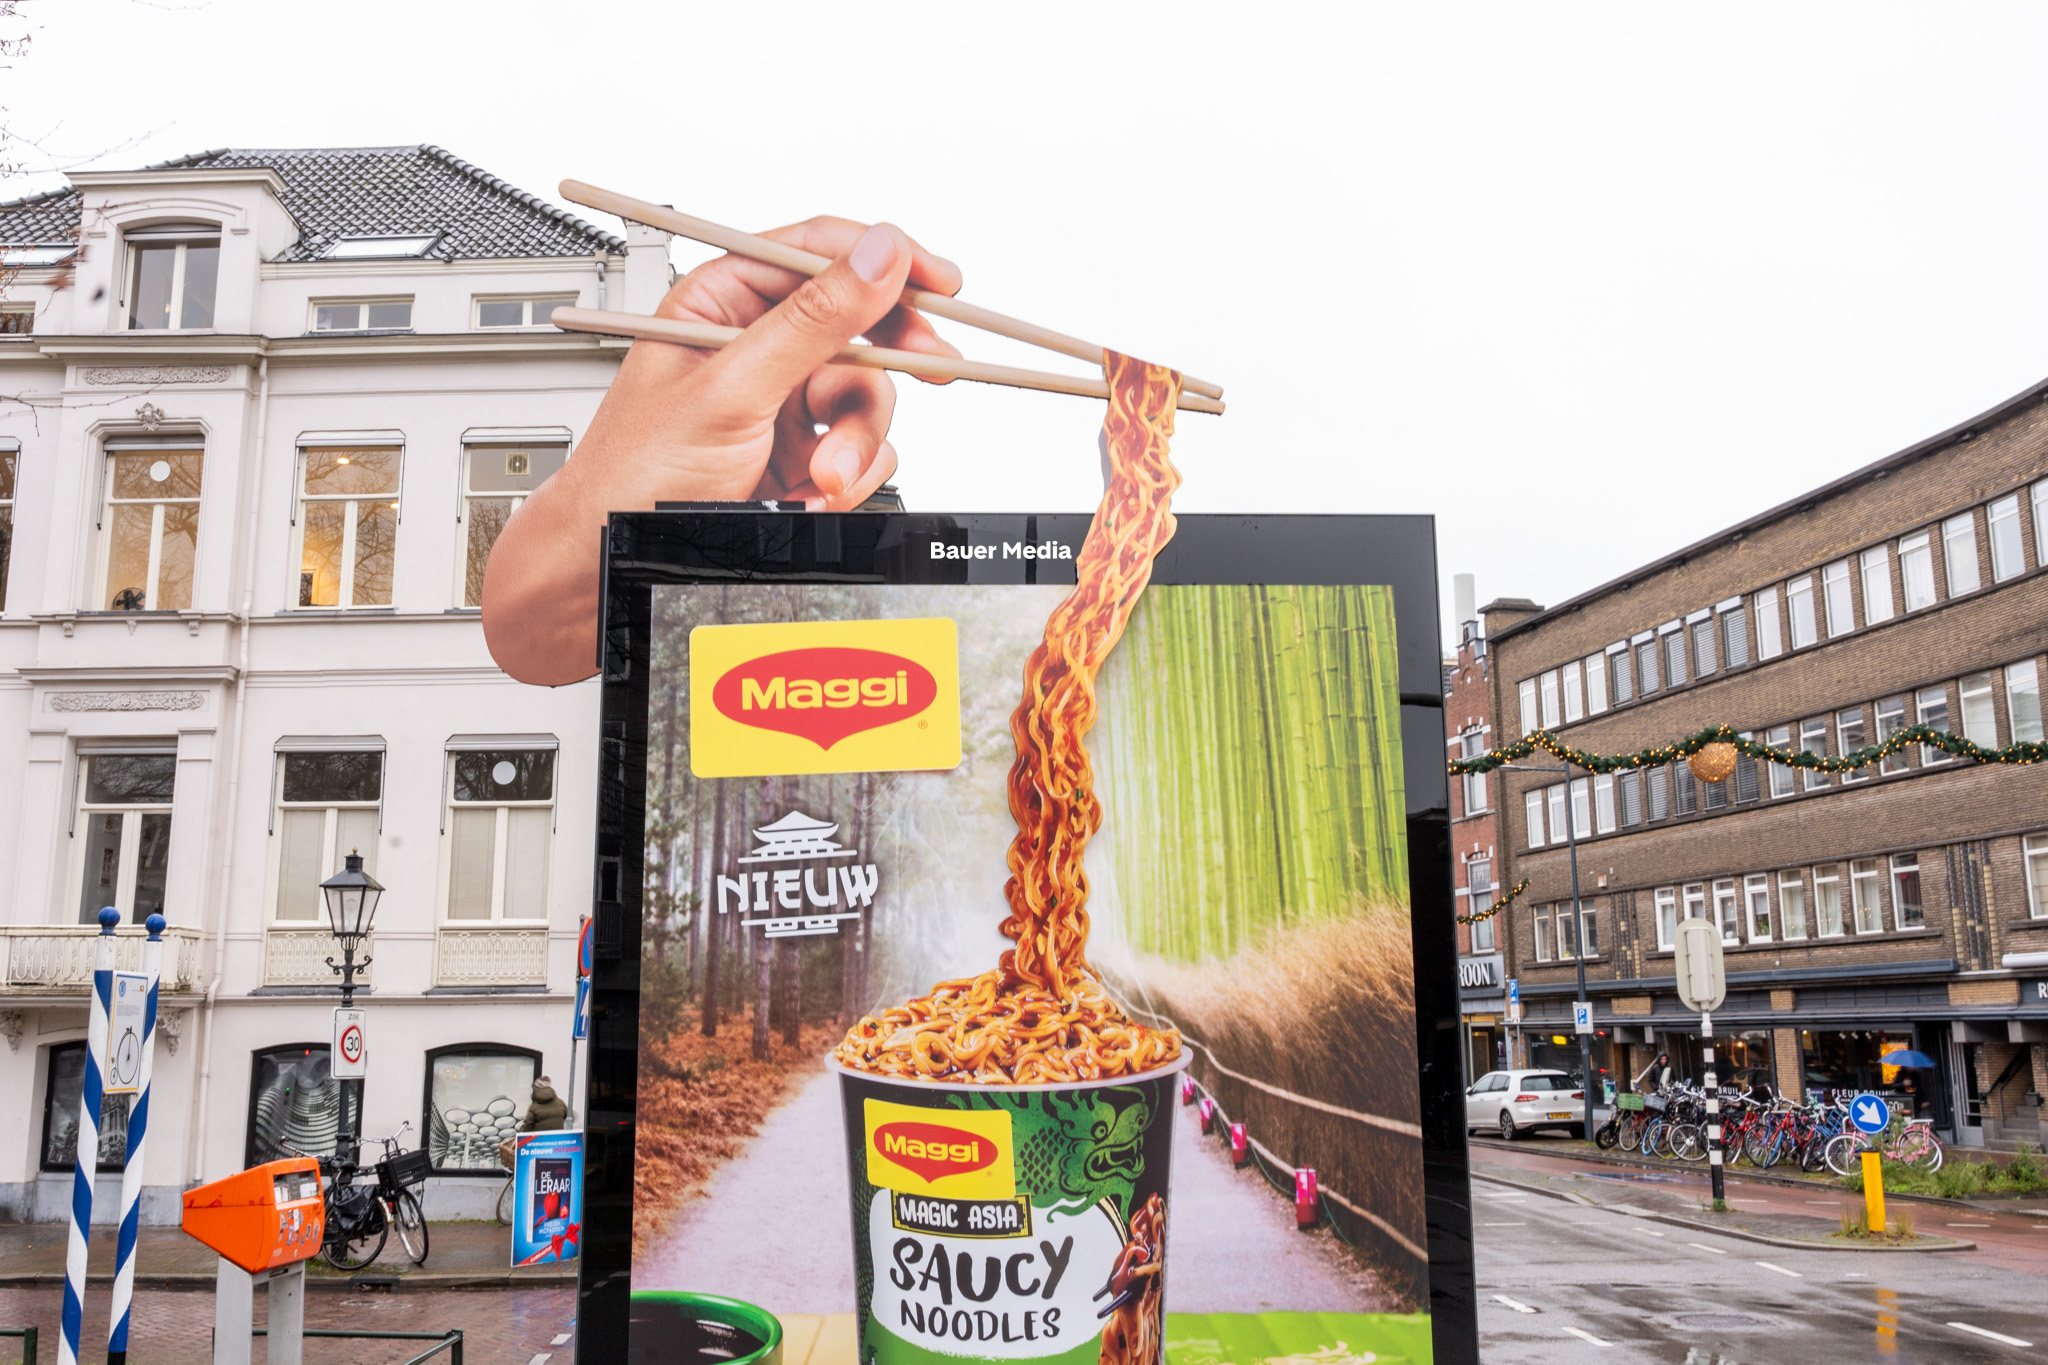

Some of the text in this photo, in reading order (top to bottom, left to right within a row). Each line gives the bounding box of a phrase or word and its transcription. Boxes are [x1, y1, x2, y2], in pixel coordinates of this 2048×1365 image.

[930, 540, 1073, 560] Bauer Media
[741, 670, 908, 711] Maggi
[717, 863, 879, 914] NIEUW
[346, 1036, 360, 1052] 30
[1831, 1088, 1859, 1098] FLEUR
[520, 1145, 581, 1156] De nieuwe McFadden
[884, 1132, 979, 1162] Maggi
[535, 1178, 571, 1195] LERAAR
[541, 1171, 552, 1180] DE
[899, 1197, 1018, 1229] MAGIC ASIA
[889, 1235, 1074, 1305] SAUCY
[900, 1299, 1061, 1343] NOODLES
